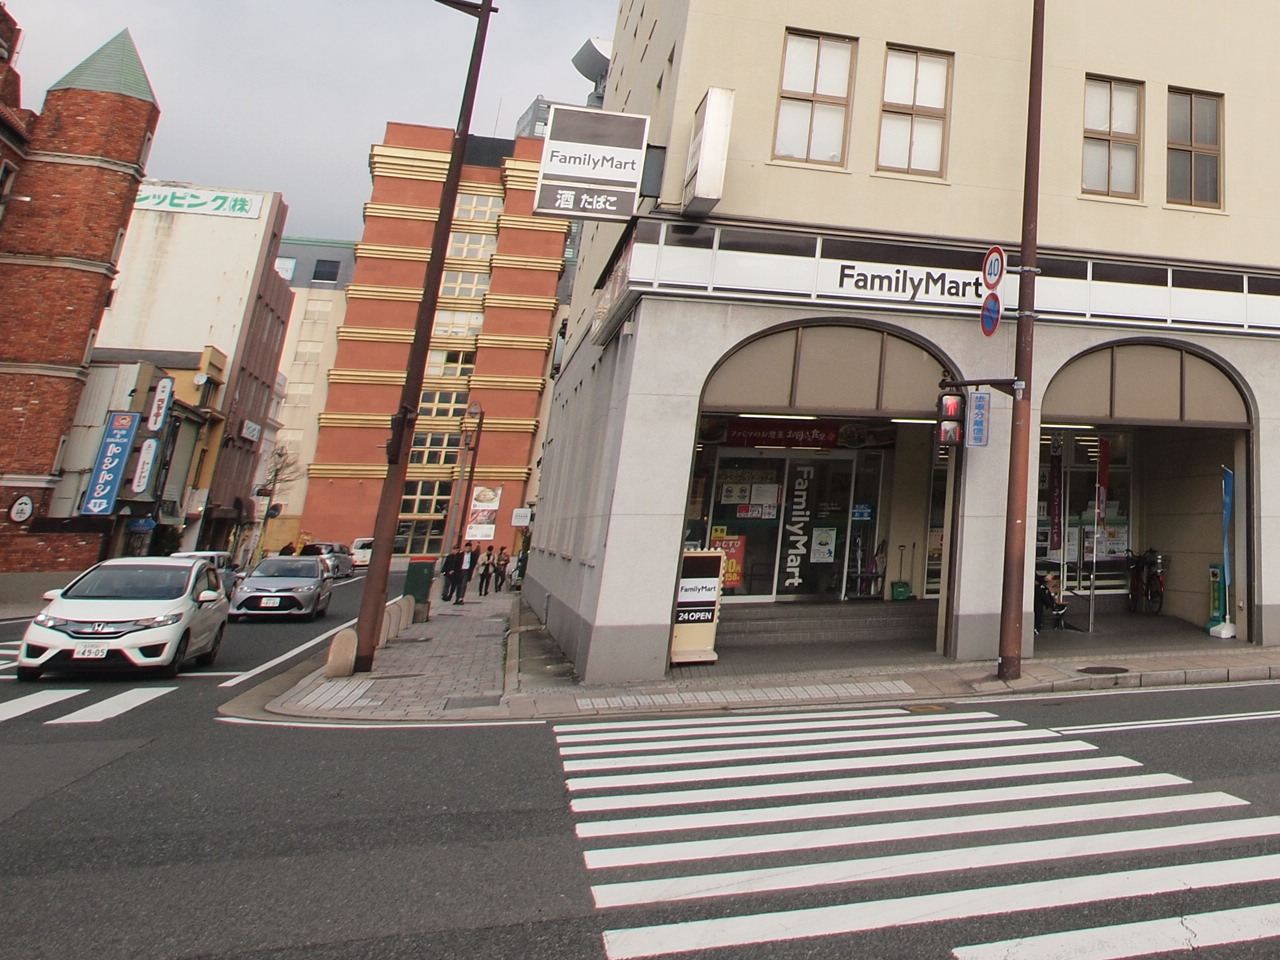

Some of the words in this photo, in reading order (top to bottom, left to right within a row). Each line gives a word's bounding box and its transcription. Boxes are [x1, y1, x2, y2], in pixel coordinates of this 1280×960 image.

[549, 150, 637, 171] FamilyMart
[555, 190, 576, 209] 酒
[580, 193, 619, 211] たばこ
[987, 258, 1001, 277] 40
[838, 264, 983, 301] FamilyMart
[785, 466, 815, 587] FamilyMart
[680, 585, 717, 594] FamilyMart
